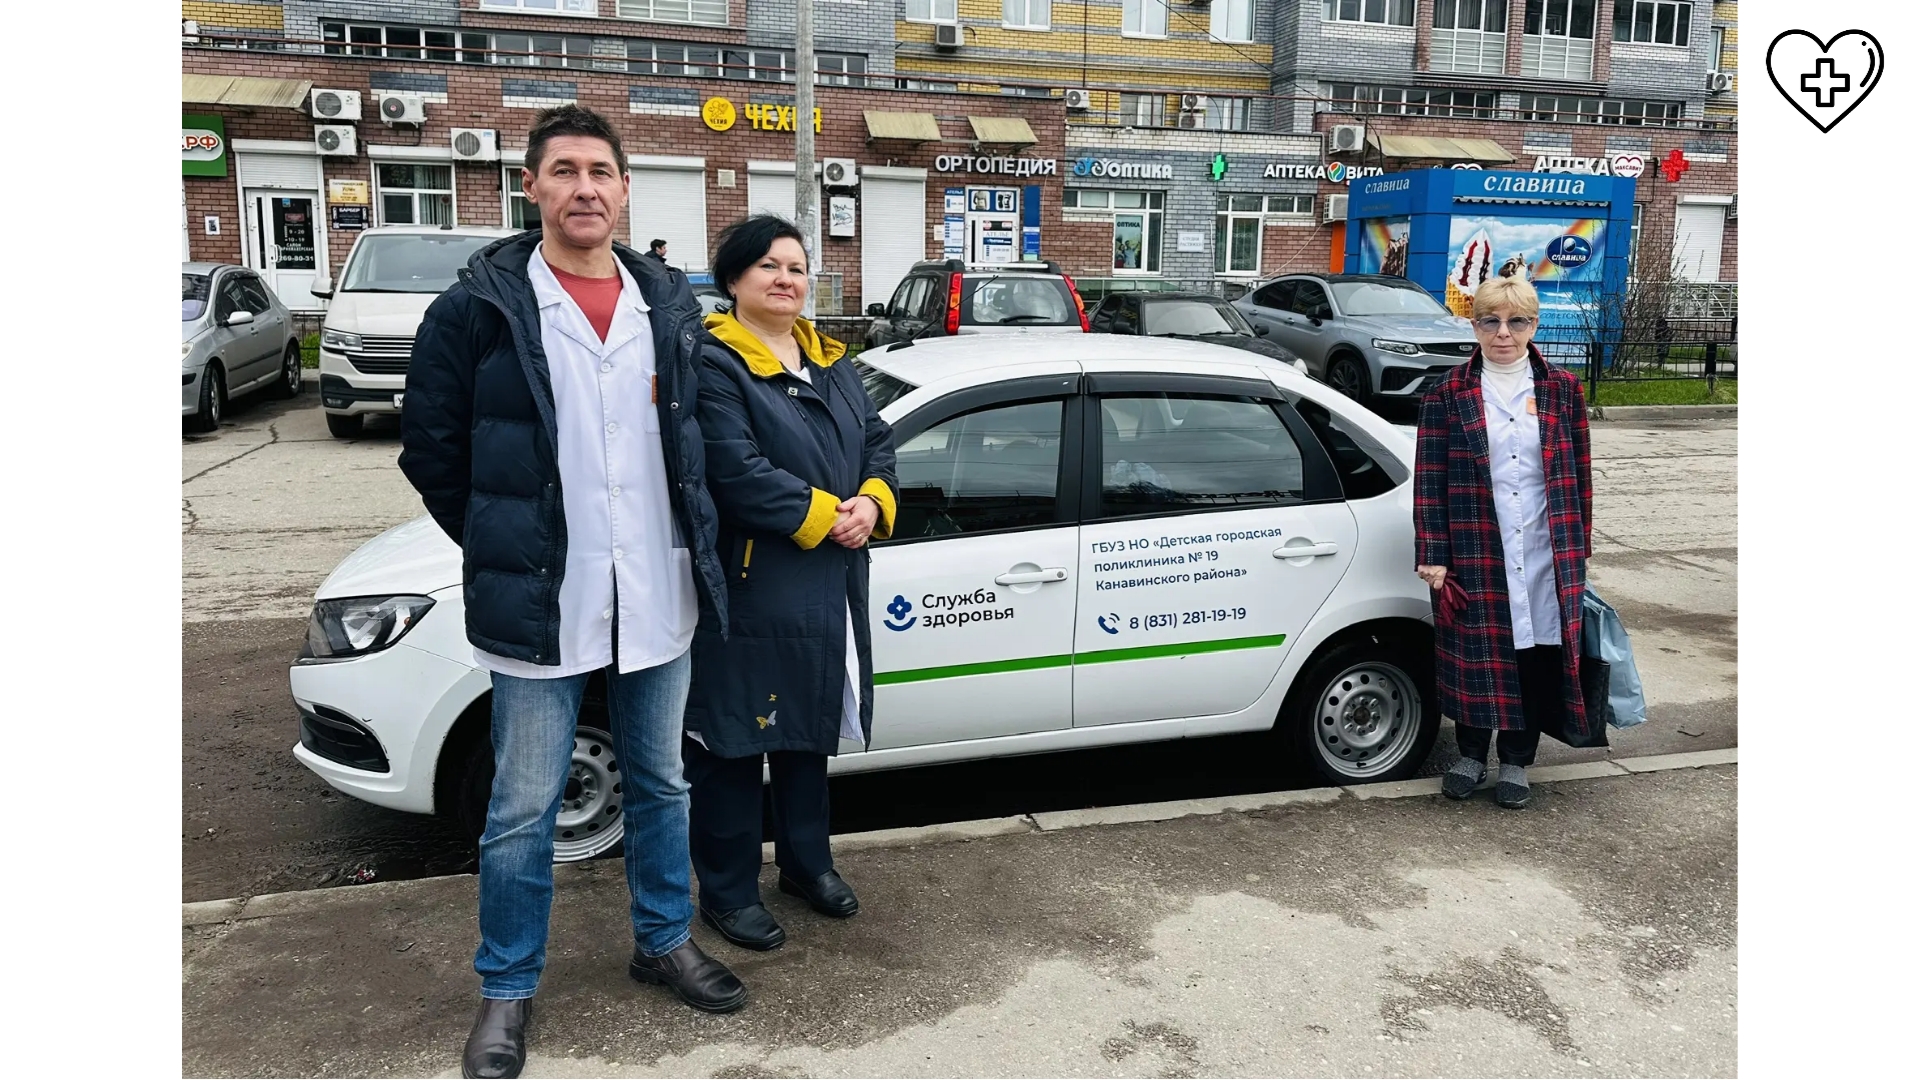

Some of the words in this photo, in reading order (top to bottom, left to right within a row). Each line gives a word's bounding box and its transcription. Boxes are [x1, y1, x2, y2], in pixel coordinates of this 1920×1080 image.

[745, 103, 822, 133] ЧЕХЯ
[935, 154, 1057, 177] ОРТОПЕДИЯ
[1263, 163, 1326, 179] АПТЕКА
[1532, 155, 1610, 177] АПТЕКА
[1365, 178, 1410, 194] славица
[1483, 175, 1585, 195] славица
[1091, 541, 1125, 554] ГБУЗ
[1128, 538, 1150, 551] НО
[1153, 531, 1213, 549] «Детская
[1215, 527, 1283, 543] городская
[1094, 556, 1185, 572] поликлиника
[1187, 551, 1204, 564] №
[1204, 549, 1220, 562] 19
[1096, 572, 1190, 591] Канавинского
[1193, 567, 1248, 583] района»
[922, 588, 996, 610] Служба
[922, 607, 1014, 628] здоровья
[1128, 615, 1140, 630] 8
[1143, 611, 1179, 631] (831)
[1181, 606, 1248, 626] 281-19-19
